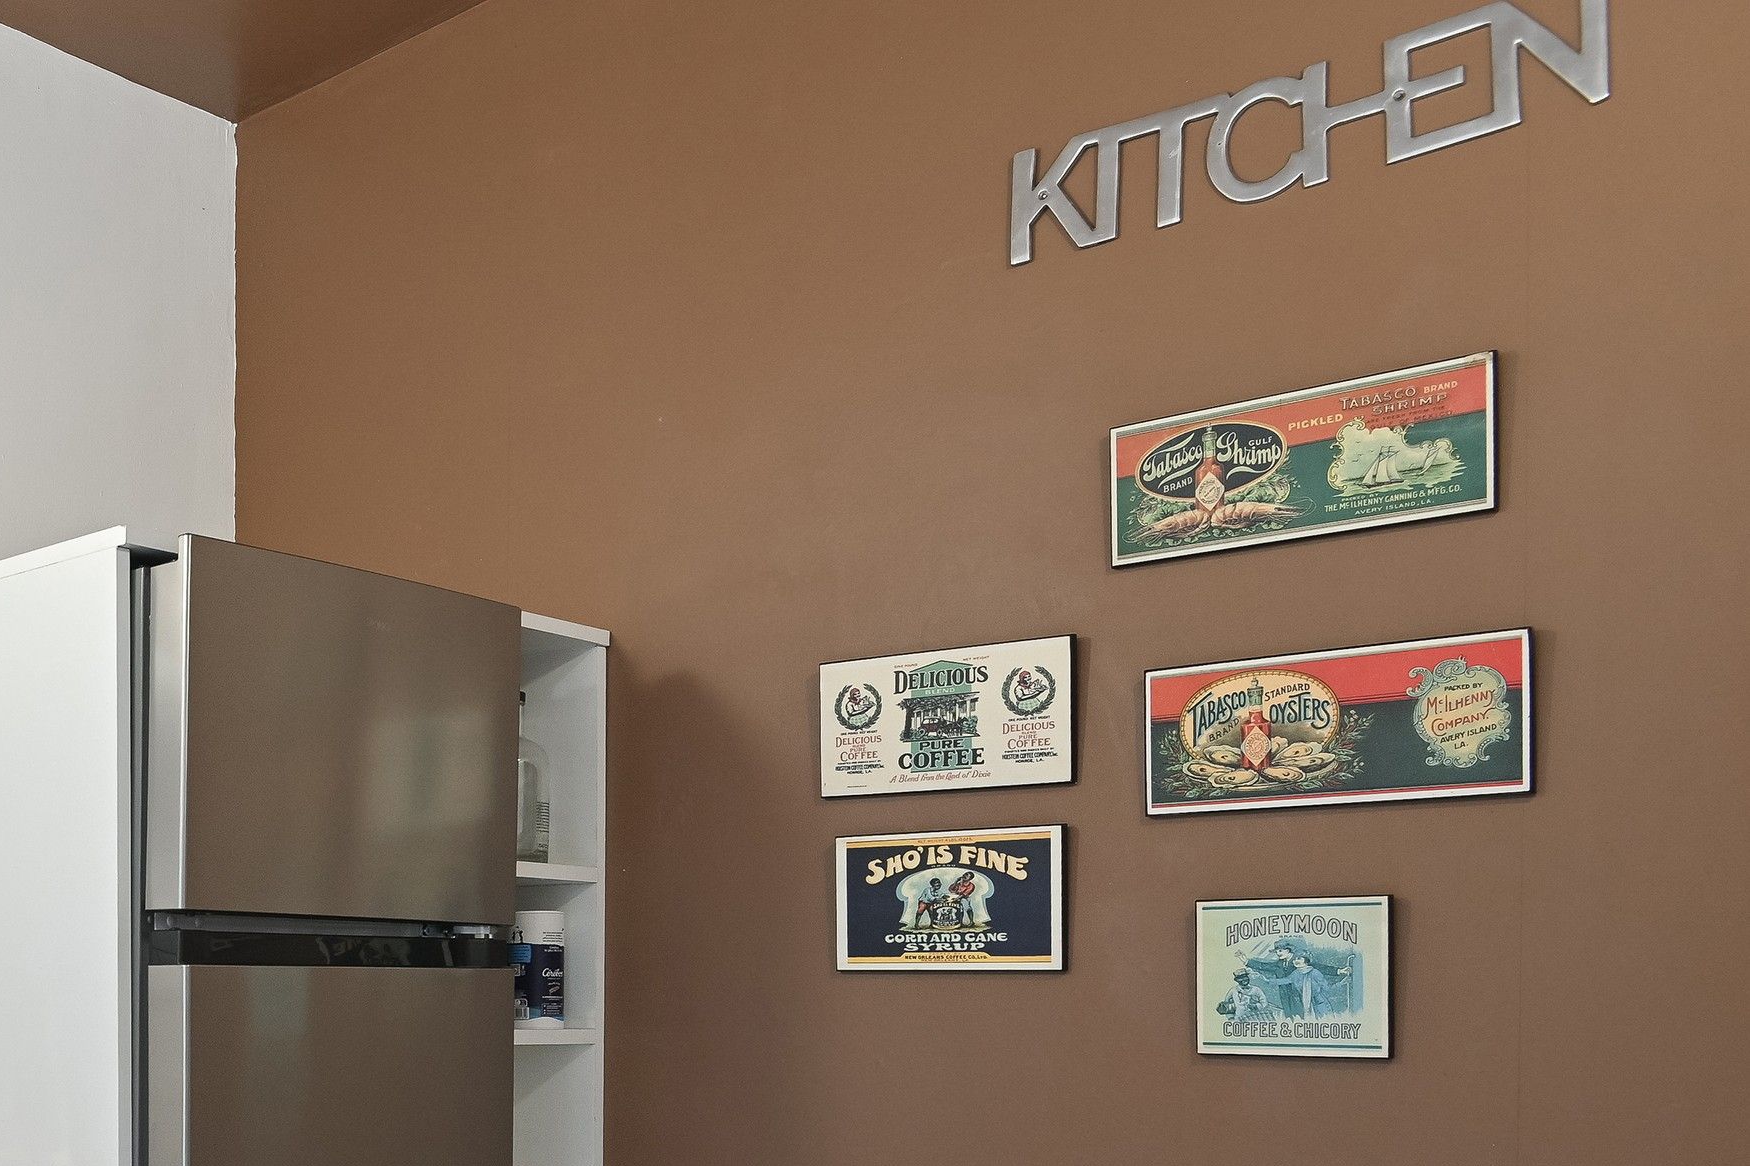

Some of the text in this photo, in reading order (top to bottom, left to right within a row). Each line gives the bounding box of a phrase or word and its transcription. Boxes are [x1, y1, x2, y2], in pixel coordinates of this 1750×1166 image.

[1010, 0, 1610, 266] KITCHEN
[1340, 381, 1458, 410] TABASCO BRAND
[1288, 393, 1447, 431] PICKLED SHRIMP
[1248, 436, 1273, 447] GULF
[1143, 433, 1203, 482] Tabasco
[1216, 432, 1281, 473] Shrimp
[1163, 476, 1193, 493] BRAND
[1324, 504, 1338, 513] THE
[1384, 491, 1418, 503] CANNING
[1419, 490, 1427, 498] &
[1354, 507, 1383, 516] AVERY
[893, 665, 989, 695] DELICIOUS
[1264, 683, 1310, 702] STANDARD
[1187, 691, 1247, 748] TABASCO
[1269, 692, 1331, 729] OYSTERS
[1002, 720, 1056, 735] DELICIOUS
[1208, 718, 1240, 742] BRAND
[1440, 723, 1497, 744] AVERY ISLAND
[835, 735, 882, 748] DELICIOUS
[919, 739, 964, 751] PURE
[1007, 737, 1051, 750] COFFEE
[1454, 741, 1469, 750] LA.
[840, 751, 878, 762] COFFEE
[898, 747, 985, 770] COFFEE
[958, 845, 1029, 881] FINE
[930, 933, 962, 942] AND
[964, 932, 1008, 942] CANE
[1225, 914, 1358, 947] HONEYMOON
[903, 942, 985, 952] SYRUP
[1222, 1021, 1362, 1040] COFFEE & CHICORY
